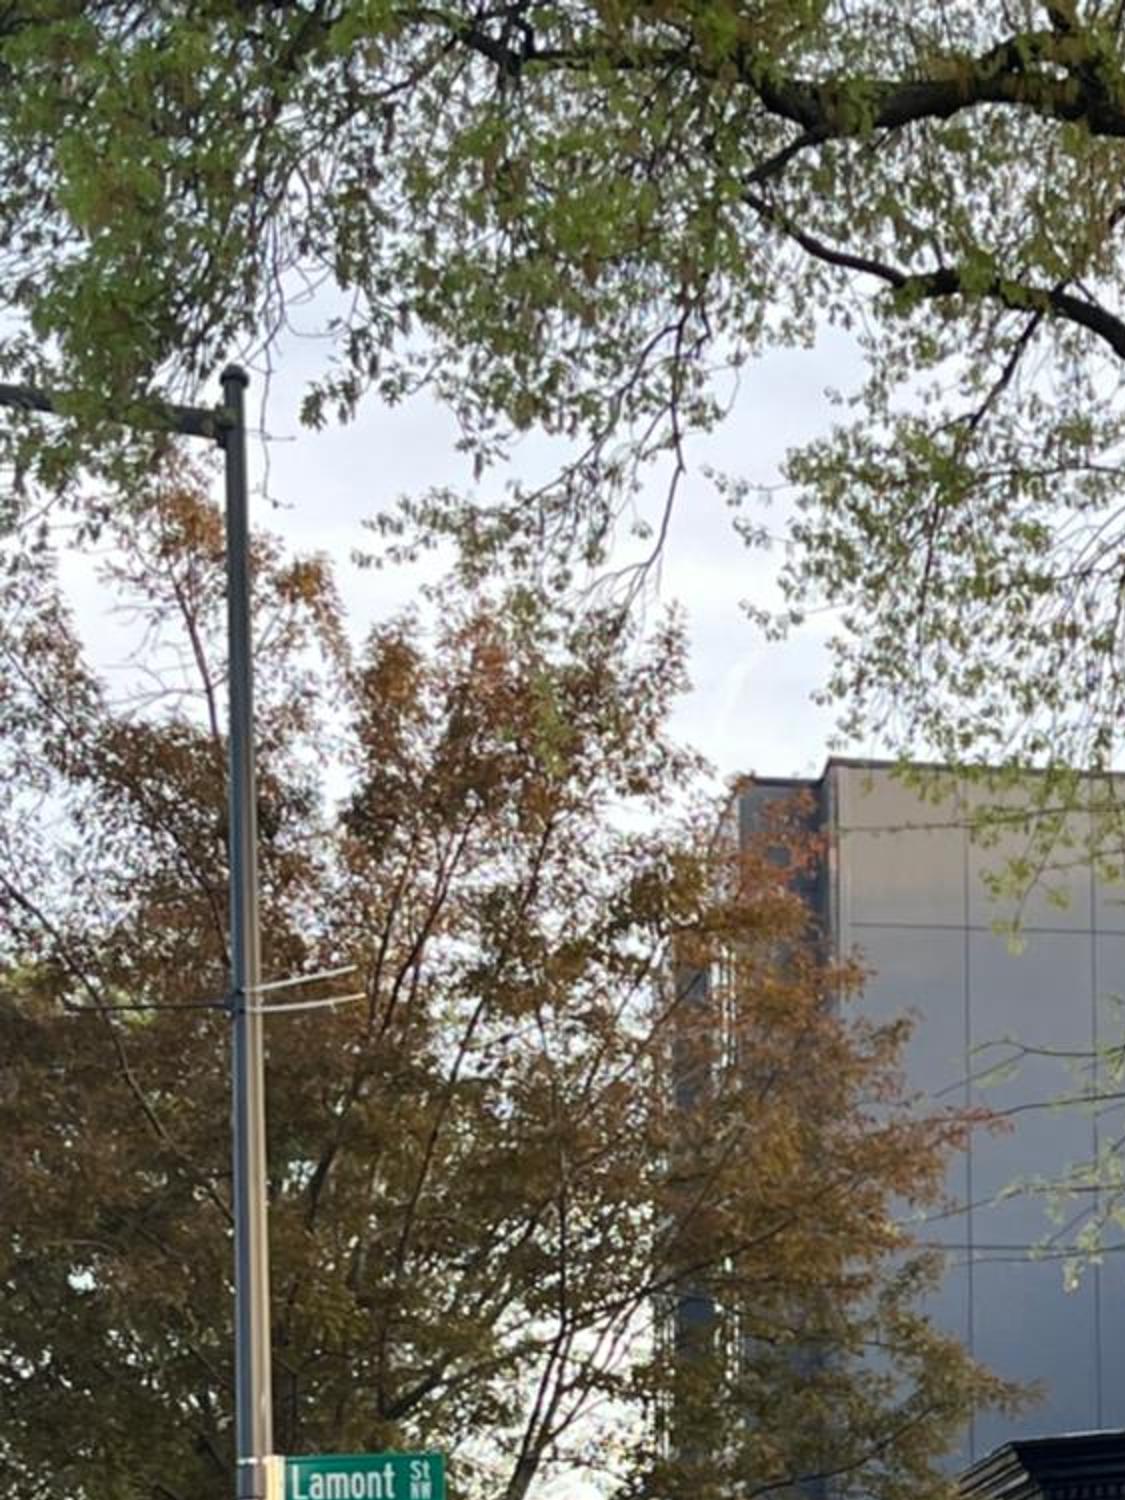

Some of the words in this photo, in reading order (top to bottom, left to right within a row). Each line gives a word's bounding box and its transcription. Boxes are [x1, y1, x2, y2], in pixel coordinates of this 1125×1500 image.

[291, 1461, 396, 1500] Lamont
[409, 1460, 431, 1481] St
[409, 1481, 433, 1500] NW
